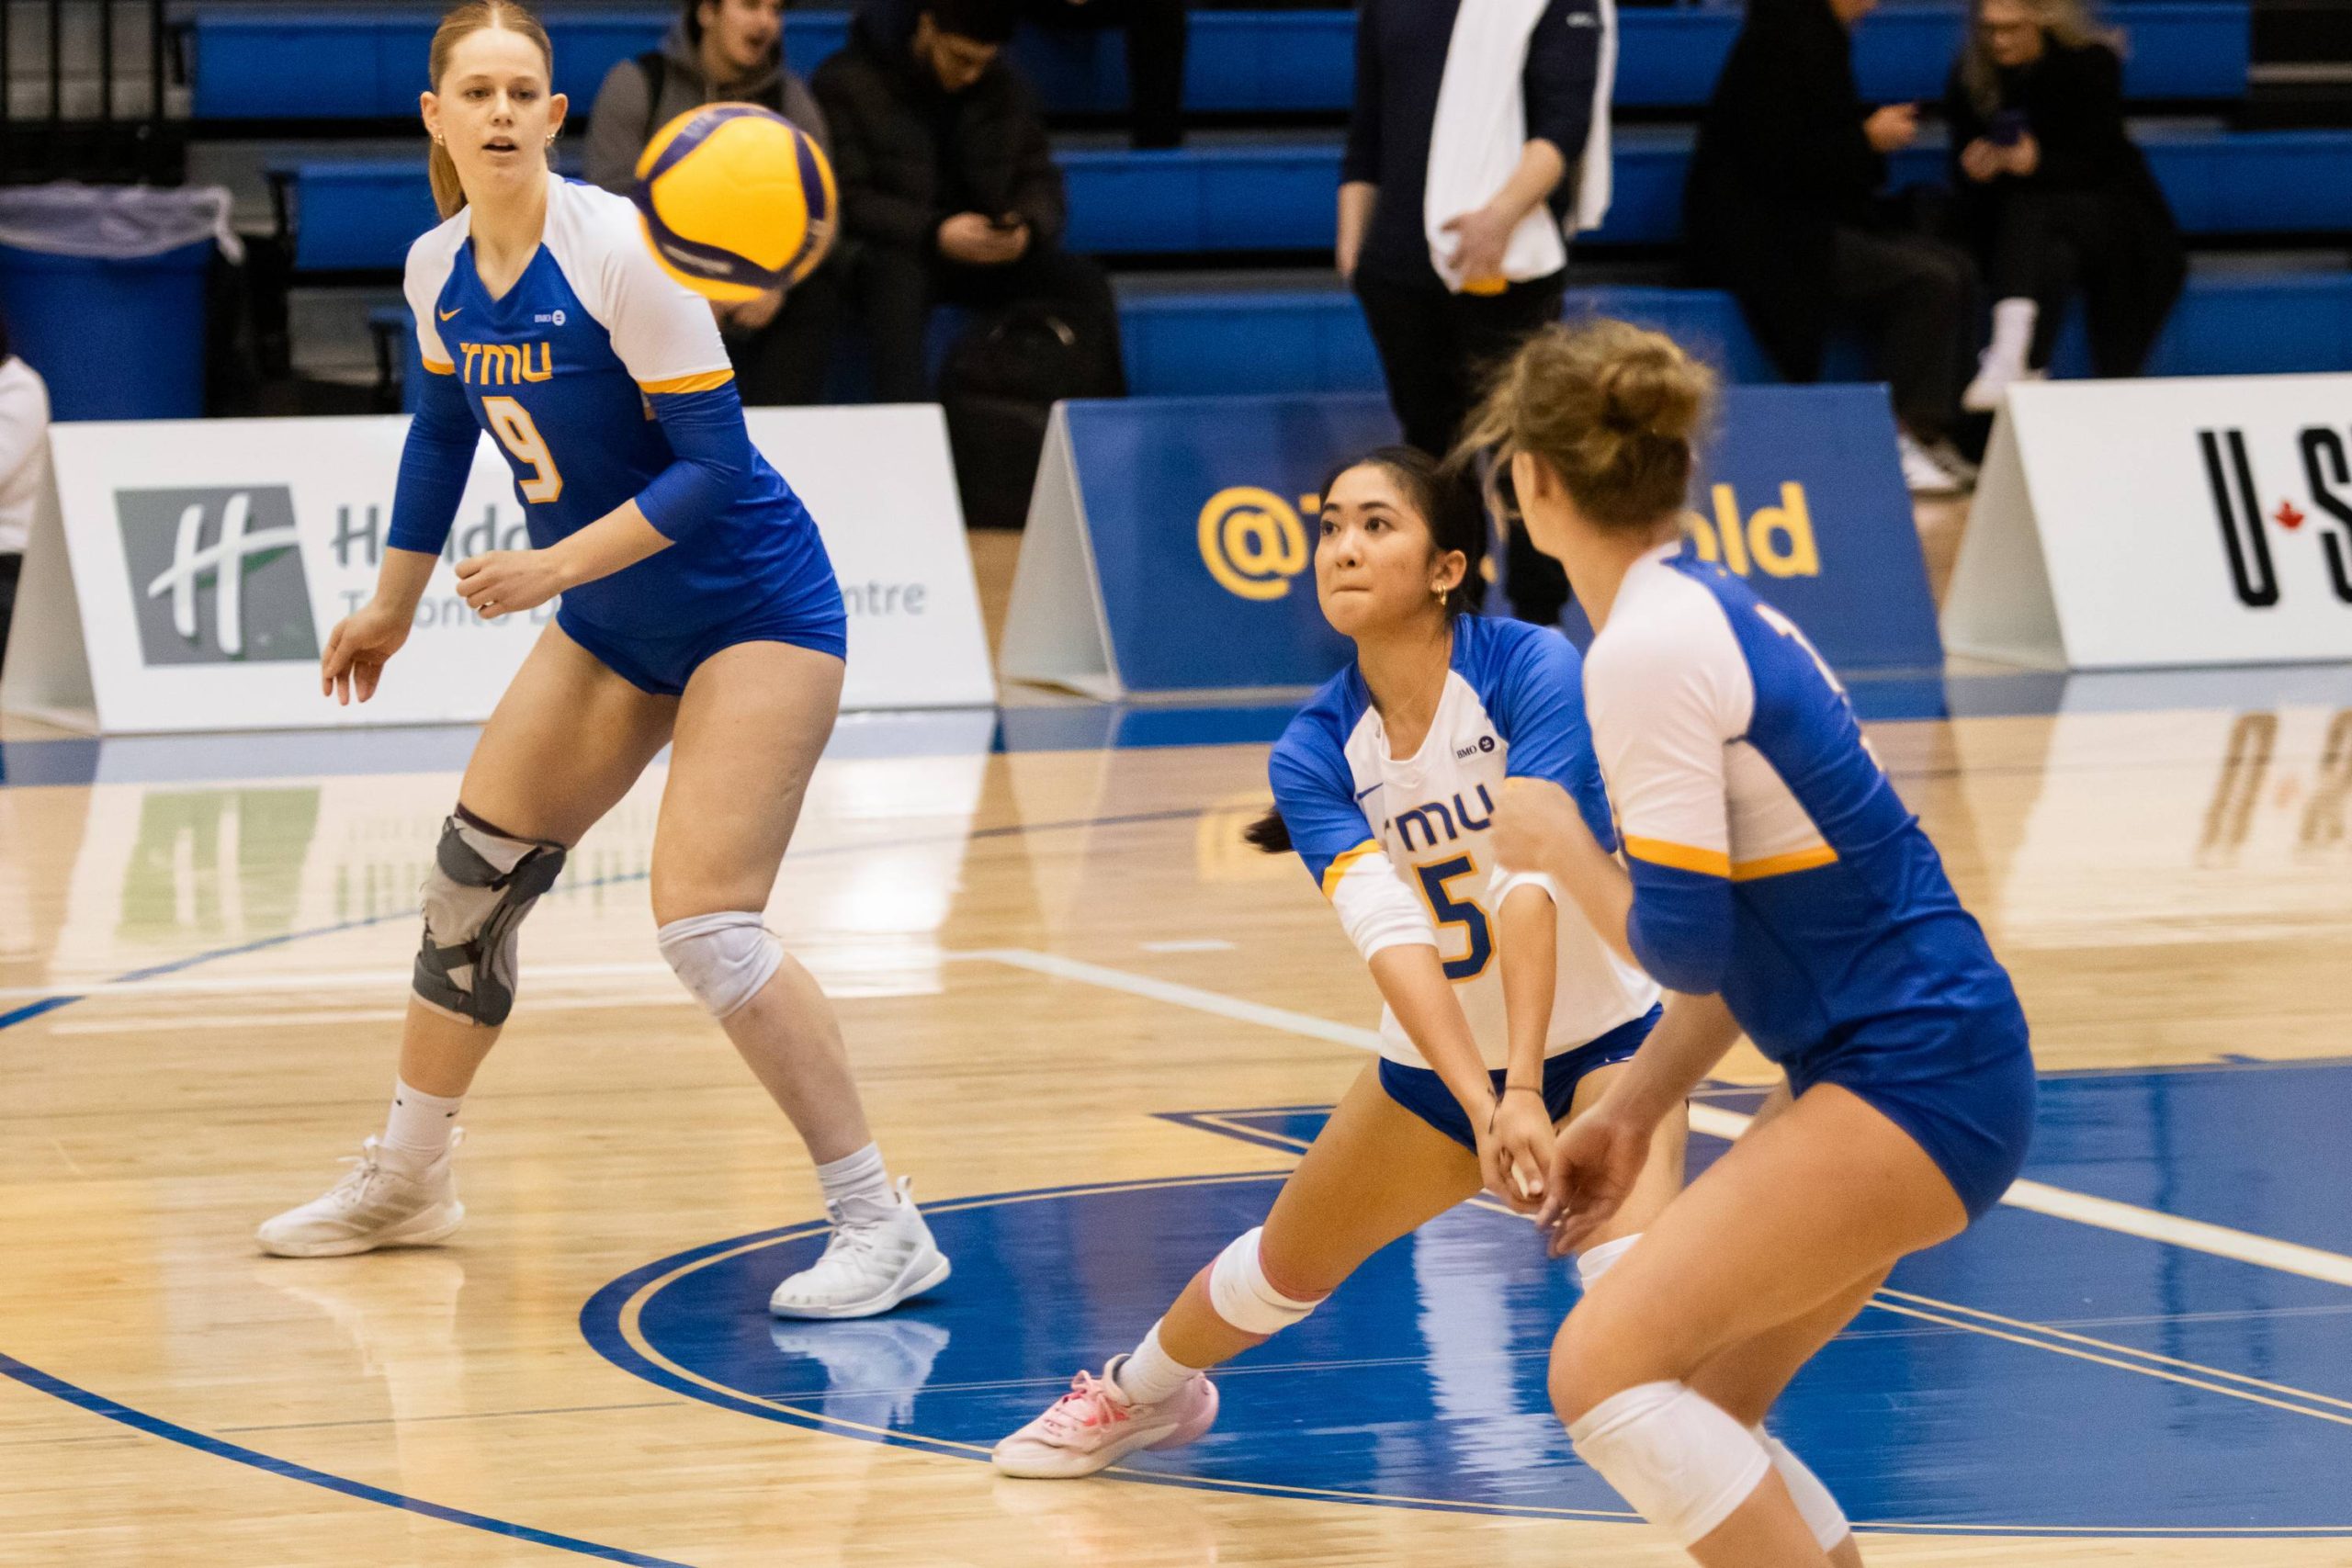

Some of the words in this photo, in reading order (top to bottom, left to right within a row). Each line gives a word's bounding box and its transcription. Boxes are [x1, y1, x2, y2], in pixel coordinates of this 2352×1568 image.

[459, 342, 552, 385] TMU
[481, 396, 564, 504] 9
[1456, 745, 1477, 760] BMO
[1384, 783, 1496, 852] MU
[1412, 850, 1498, 984] 5
